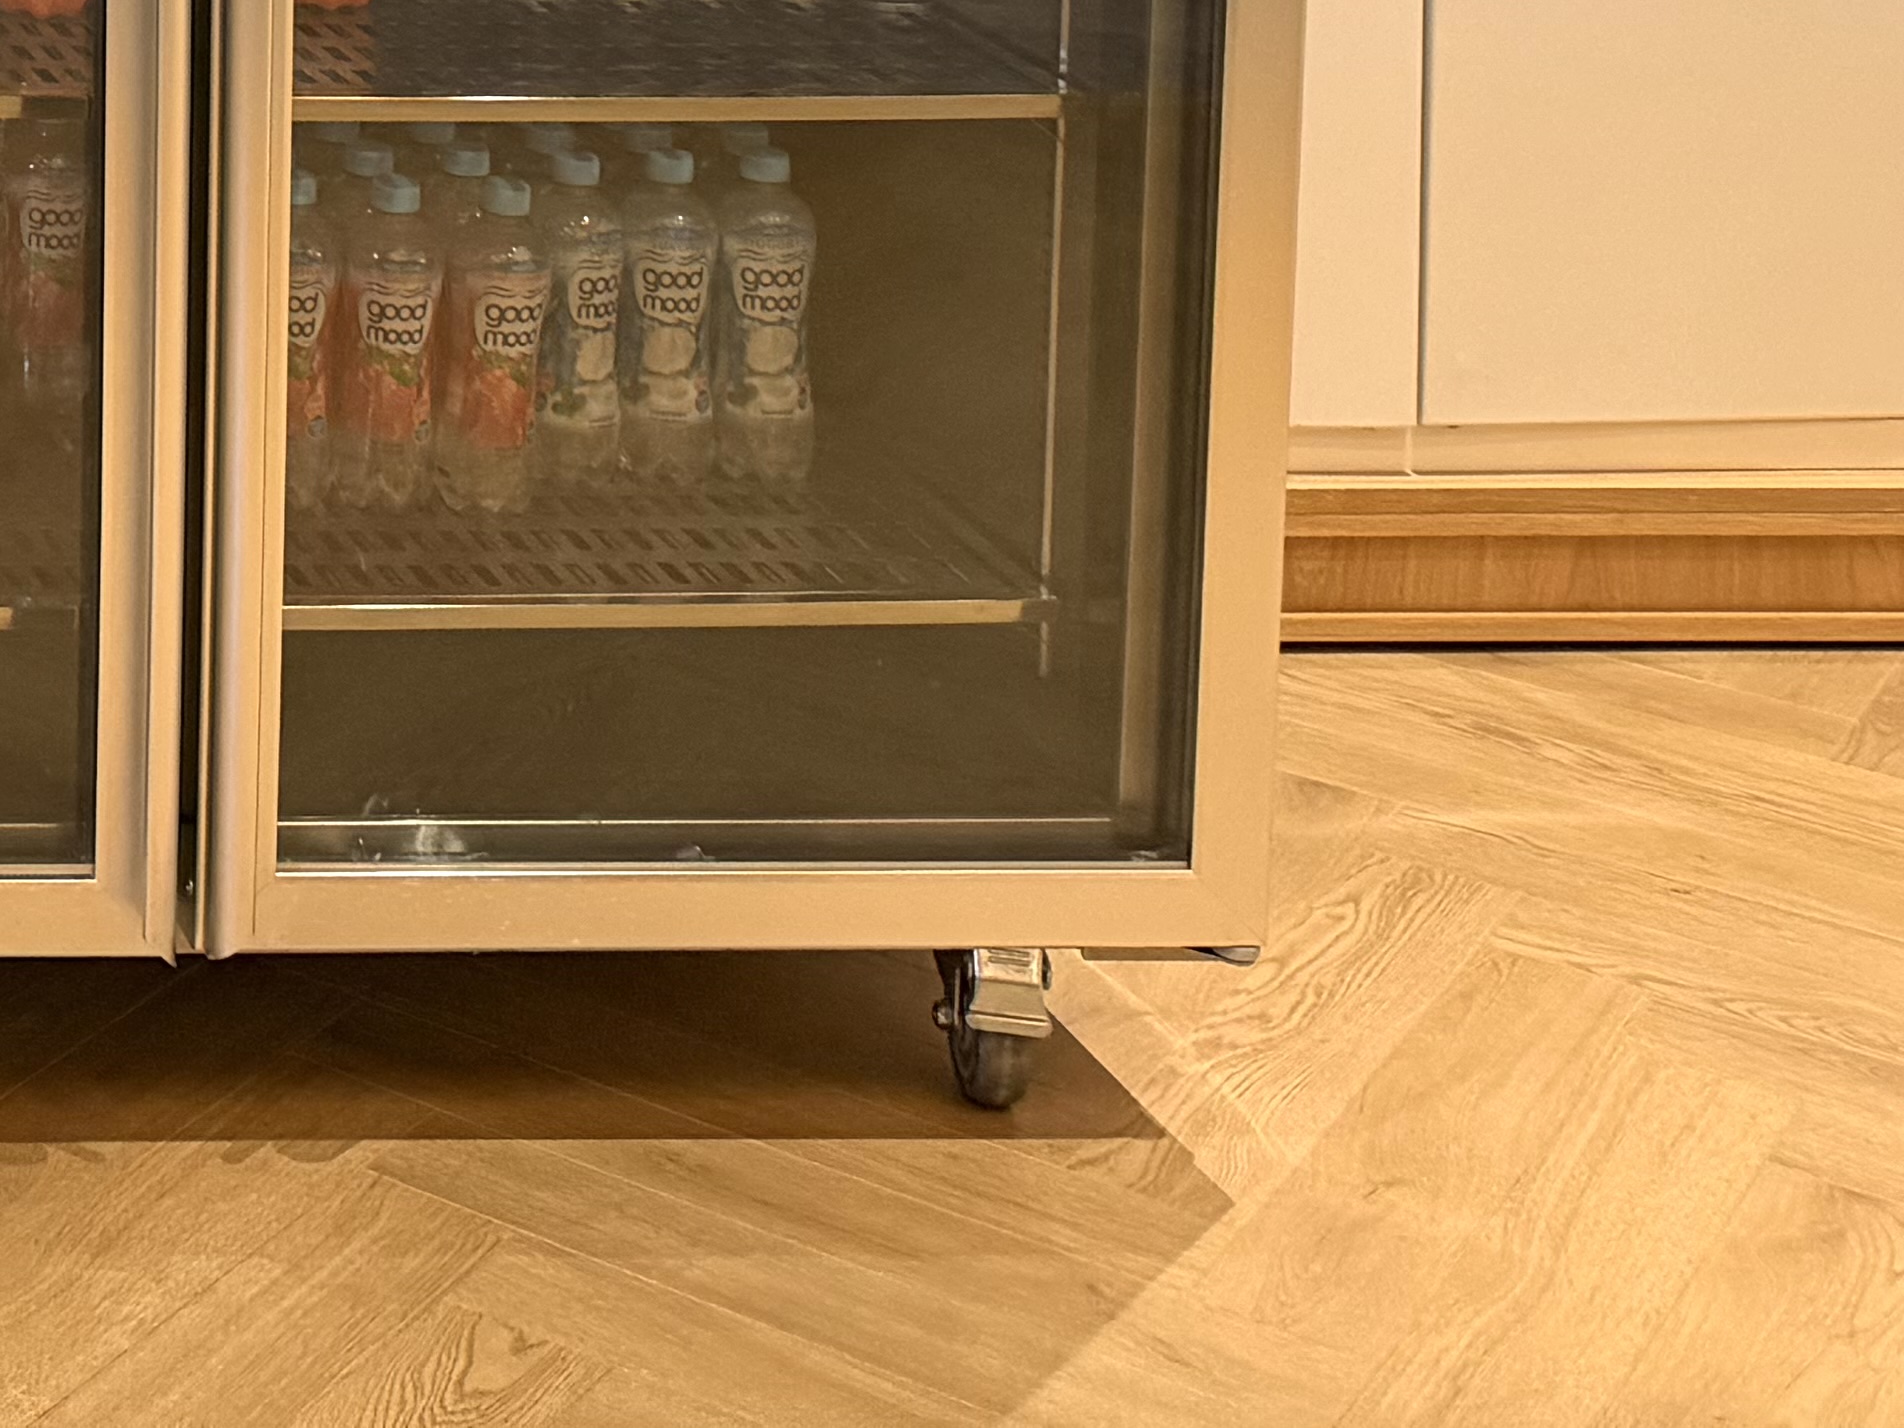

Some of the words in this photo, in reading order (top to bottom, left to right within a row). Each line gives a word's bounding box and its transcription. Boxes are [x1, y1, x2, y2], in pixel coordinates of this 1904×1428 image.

[642, 266, 704, 293] good
[740, 264, 805, 292] good
[365, 298, 428, 324] good
[643, 293, 701, 314] mood
[742, 289, 802, 313] mood
[366, 324, 424, 345] mood
